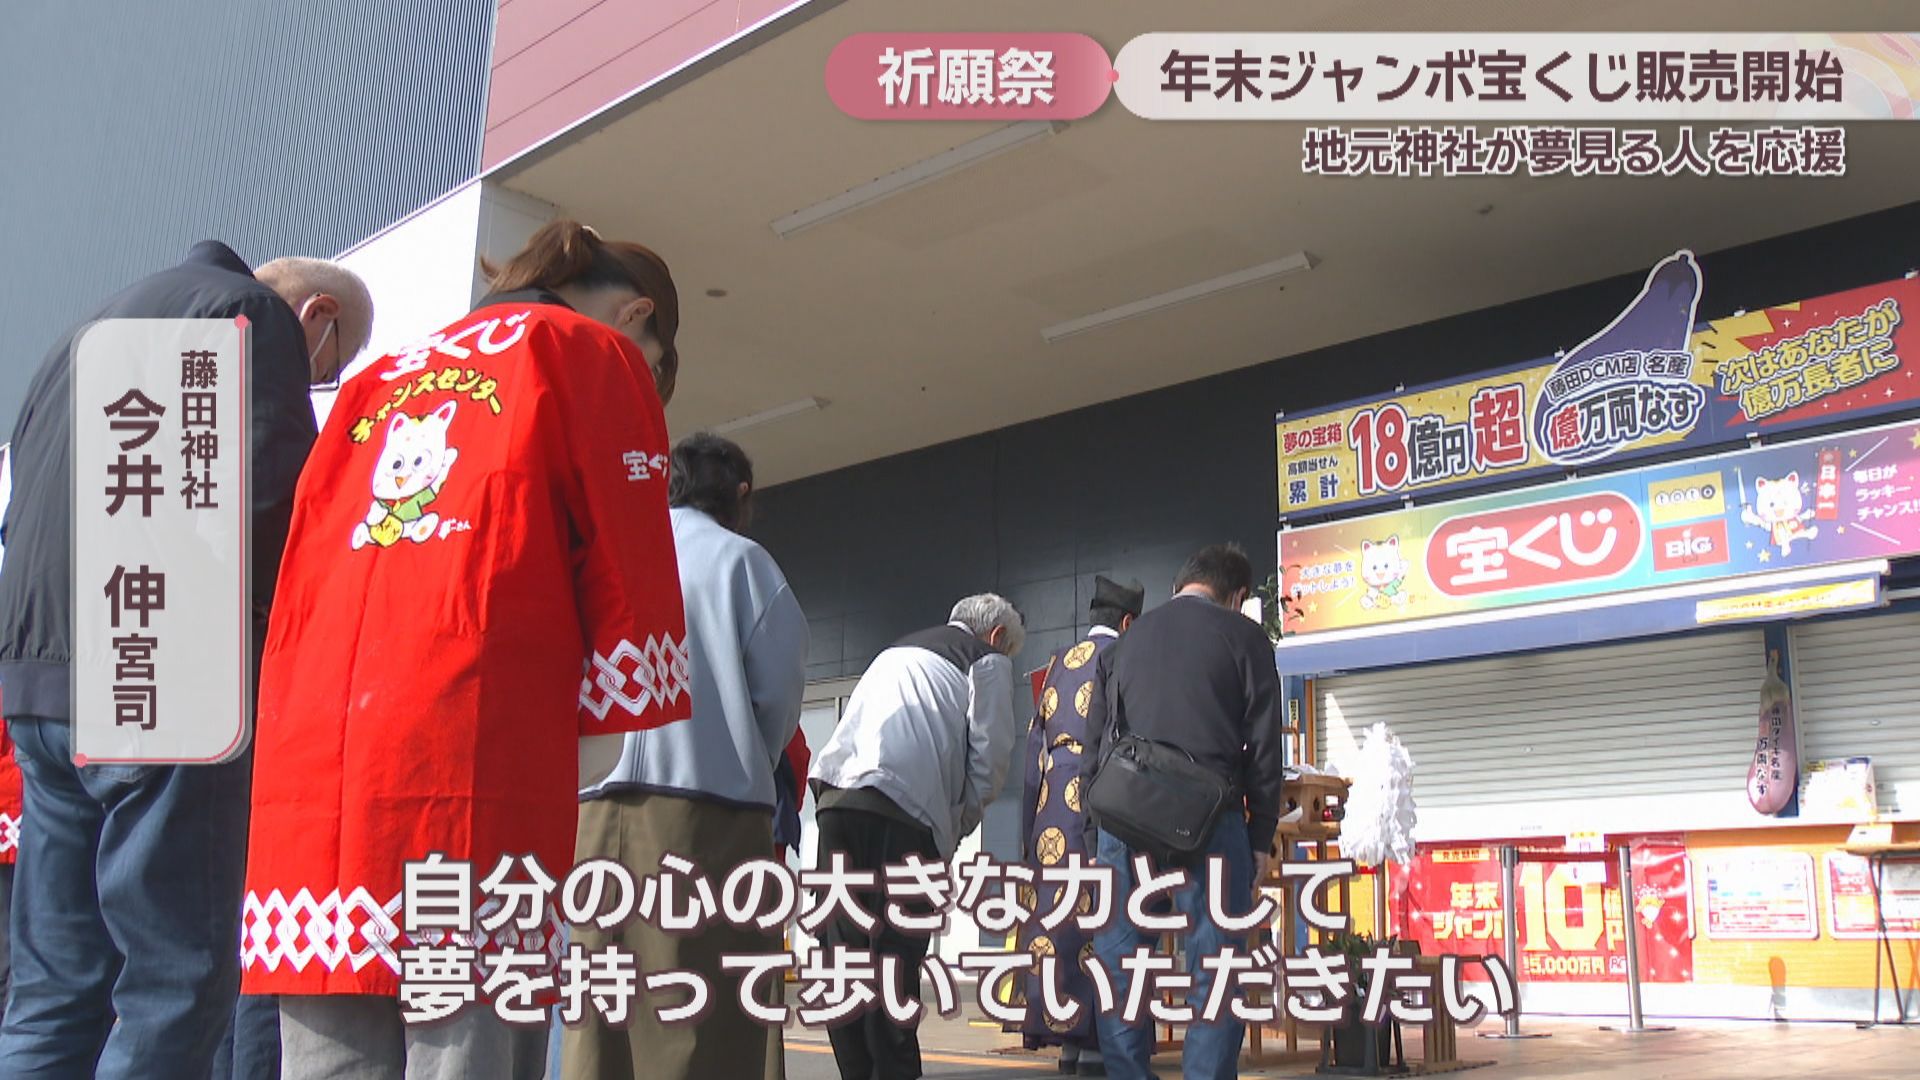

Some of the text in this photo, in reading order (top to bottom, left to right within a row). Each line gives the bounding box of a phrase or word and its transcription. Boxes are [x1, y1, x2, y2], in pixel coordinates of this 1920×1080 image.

[1719, 302, 1897, 393] 次はあなたが
[1744, 340, 1896, 417] 億万長者に
[350, 367, 502, 443] チャンスセンター
[1550, 386, 1695, 450] 億万両なす
[1283, 422, 1342, 453] 夢の宝箱
[1288, 455, 1338, 476] 高額当せん
[1856, 484, 1912, 502] ラッキー
[1446, 508, 1616, 586] 宝くじ
[1450, 882, 1499, 909] 年末
